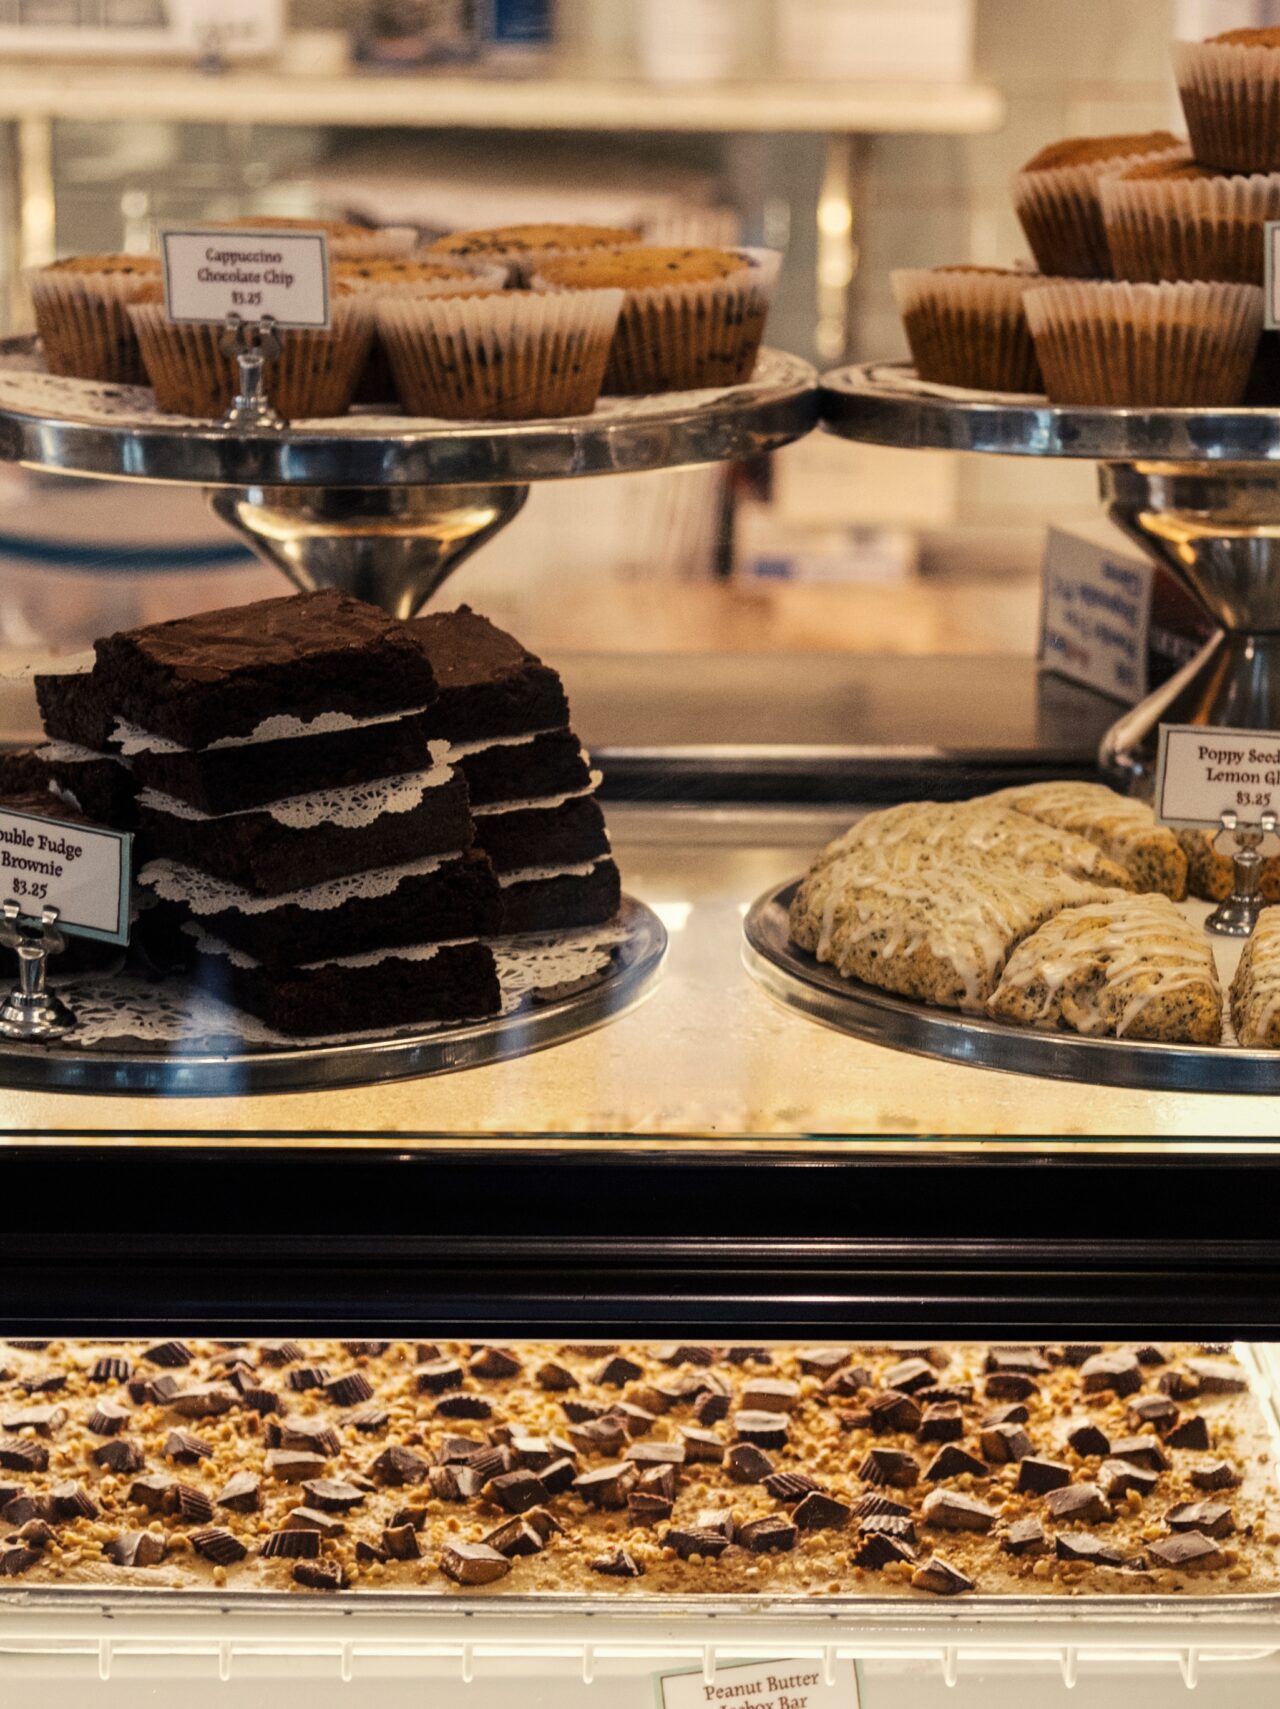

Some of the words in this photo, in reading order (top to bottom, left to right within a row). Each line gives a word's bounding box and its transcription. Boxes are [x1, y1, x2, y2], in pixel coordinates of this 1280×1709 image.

[205, 247, 283, 266] Cappuccino
[197, 268, 261, 284] Chocolate
[263, 269, 294, 289] Chip
[1198, 745, 1245, 766] Poppy
[1205, 767, 1260, 785] Lemon
[1236, 790, 1272, 807] $3.25
[0, 828, 35, 848] ouble
[38, 835, 83, 861] Fudge
[1, 850, 63, 878] Brownie
[12, 877, 48, 900] $3.25
[703, 1680, 763, 1701] Peanut
[766, 1672, 820, 1693] Butter
[778, 1695, 808, 1709] Bar
